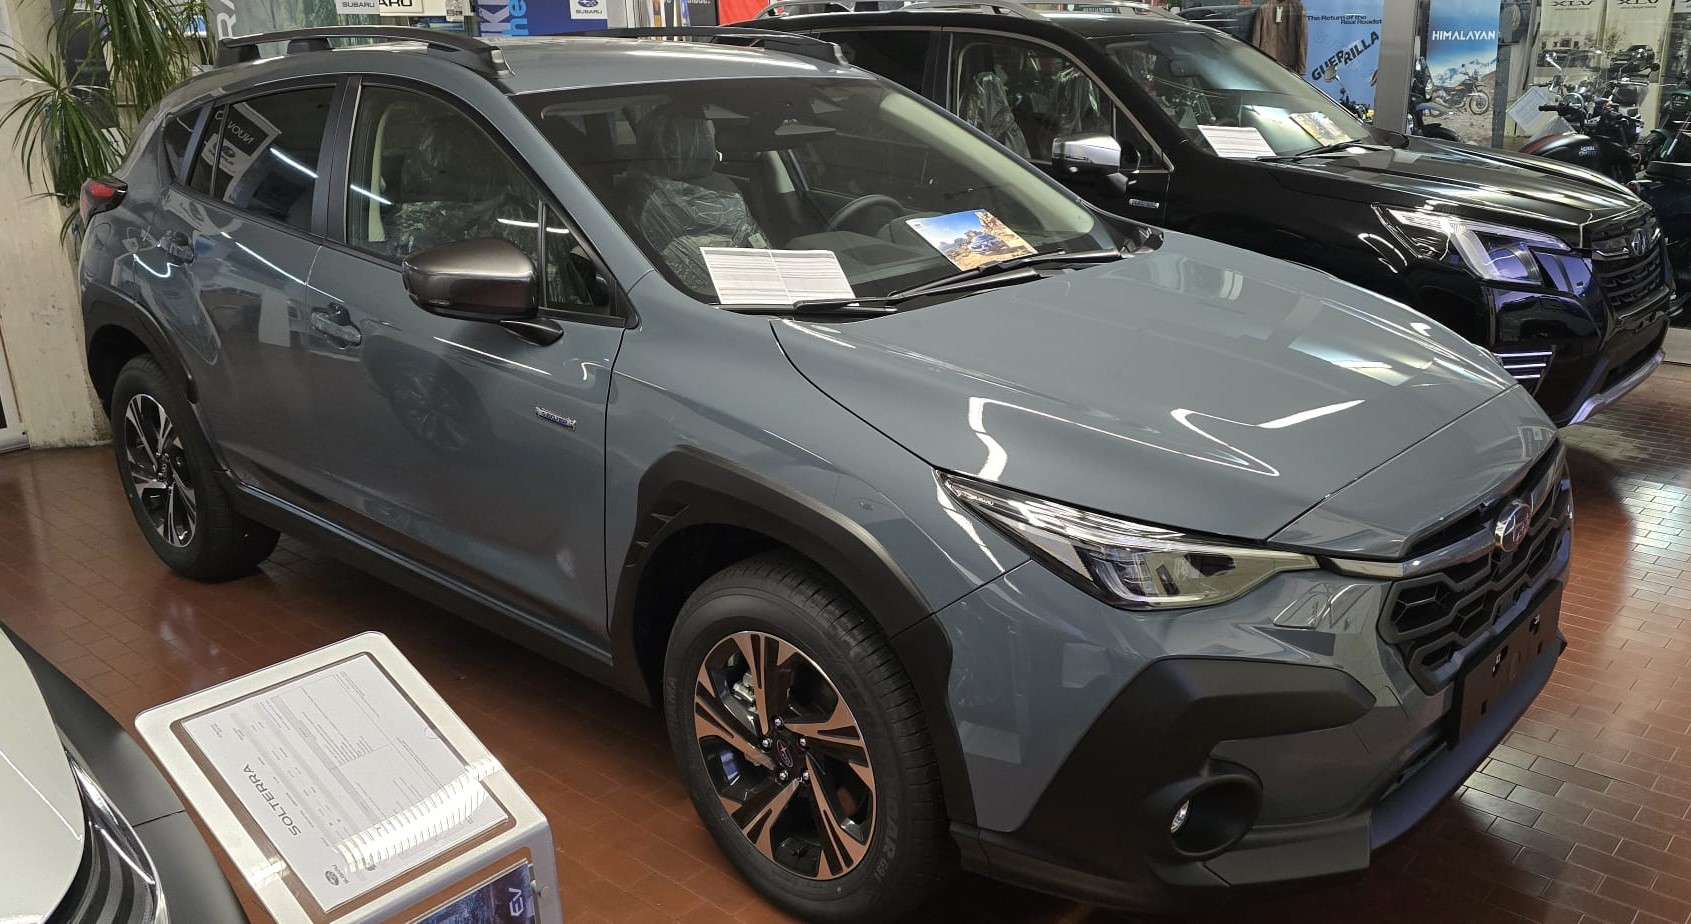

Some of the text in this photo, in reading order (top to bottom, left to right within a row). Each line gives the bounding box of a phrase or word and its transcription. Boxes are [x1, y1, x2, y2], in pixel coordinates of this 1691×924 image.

[1311, 30, 1380, 81] GUERRILLA
[1431, 30, 1496, 41] HIMALAYAN
[243, 763, 303, 837] SOLTERRA
[507, 887, 525, 917] EV
